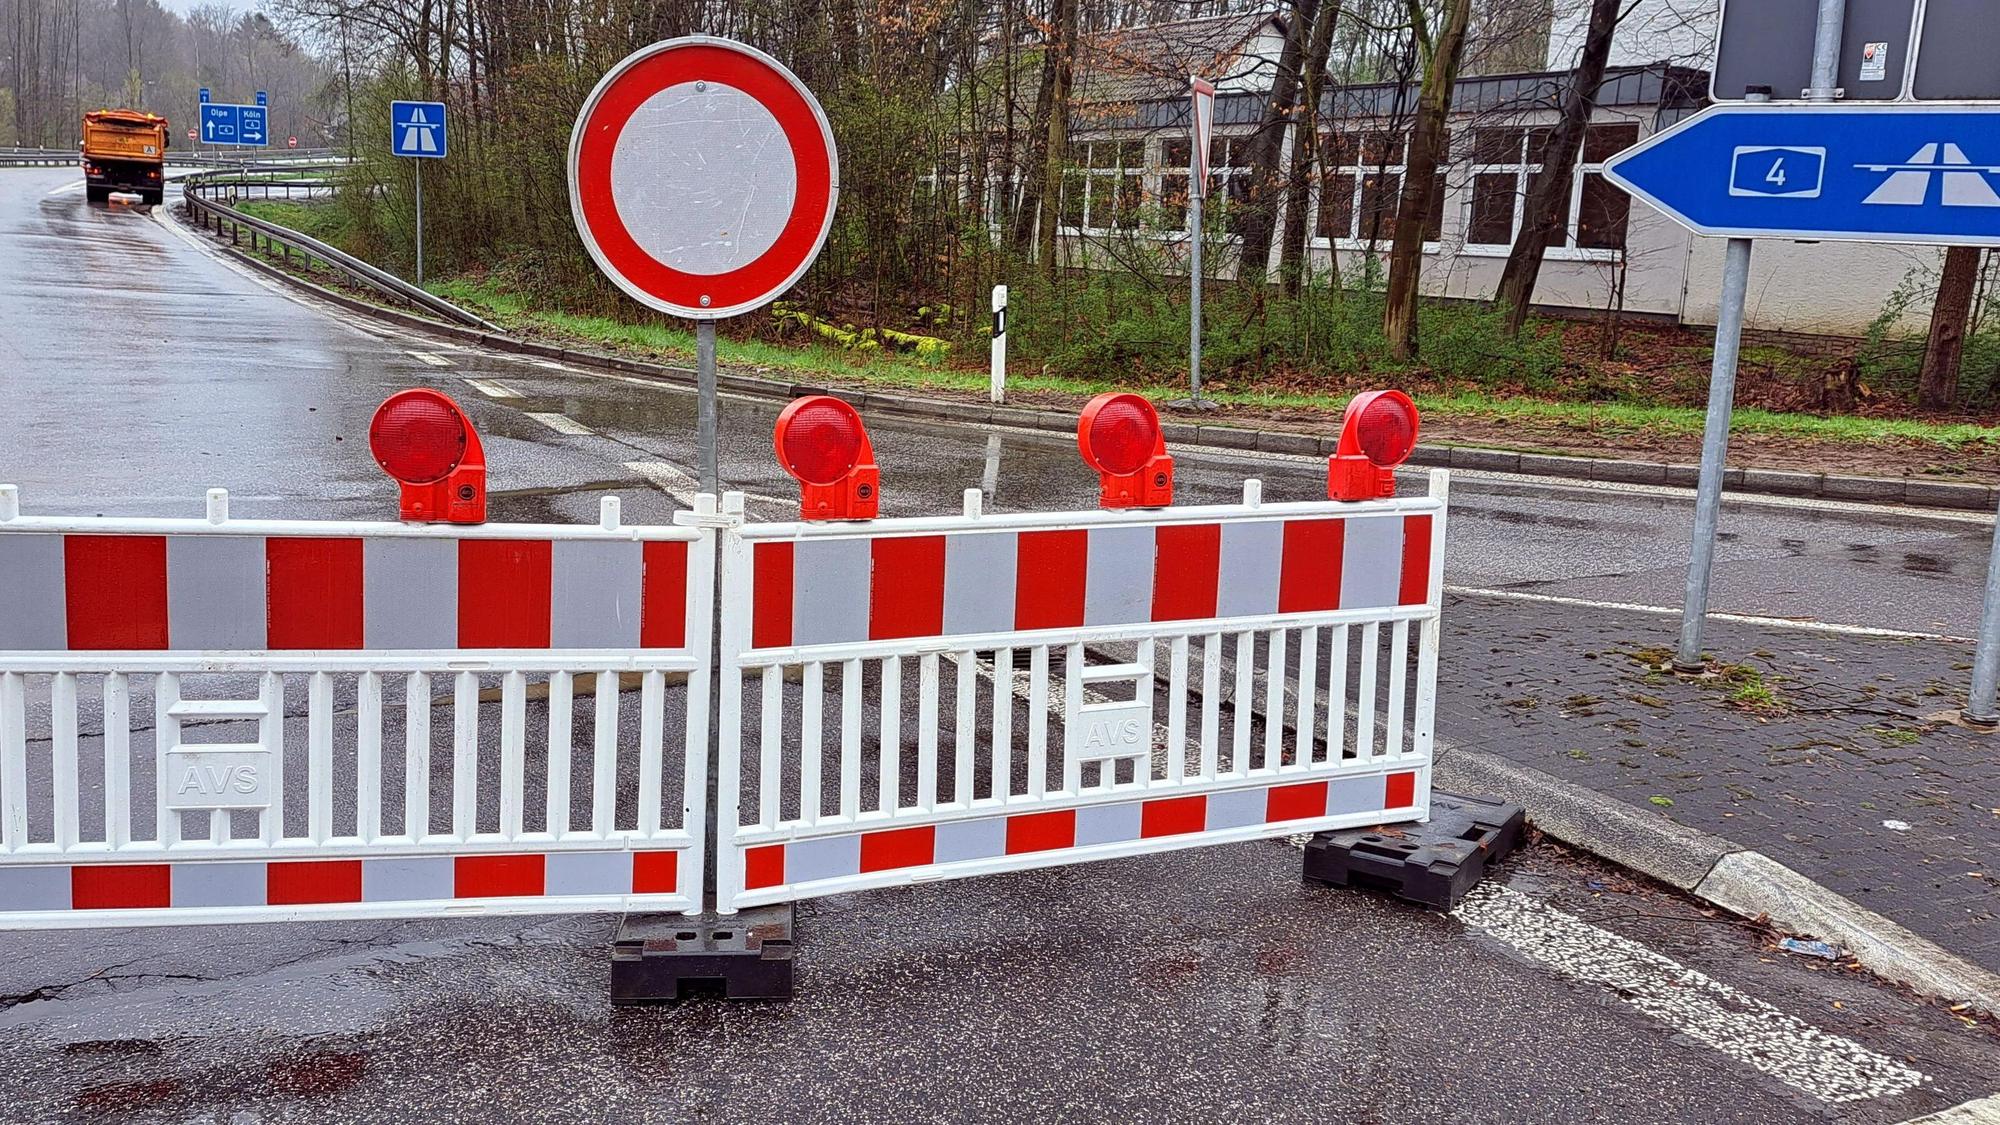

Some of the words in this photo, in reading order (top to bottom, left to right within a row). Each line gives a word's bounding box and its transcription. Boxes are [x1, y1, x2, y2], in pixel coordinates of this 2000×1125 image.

[211, 108, 228, 118] Olpe
[243, 110, 261, 119] Köln
[1766, 157, 1785, 186] 4
[1084, 718, 1140, 749] AVS
[177, 765, 258, 795] AVS
